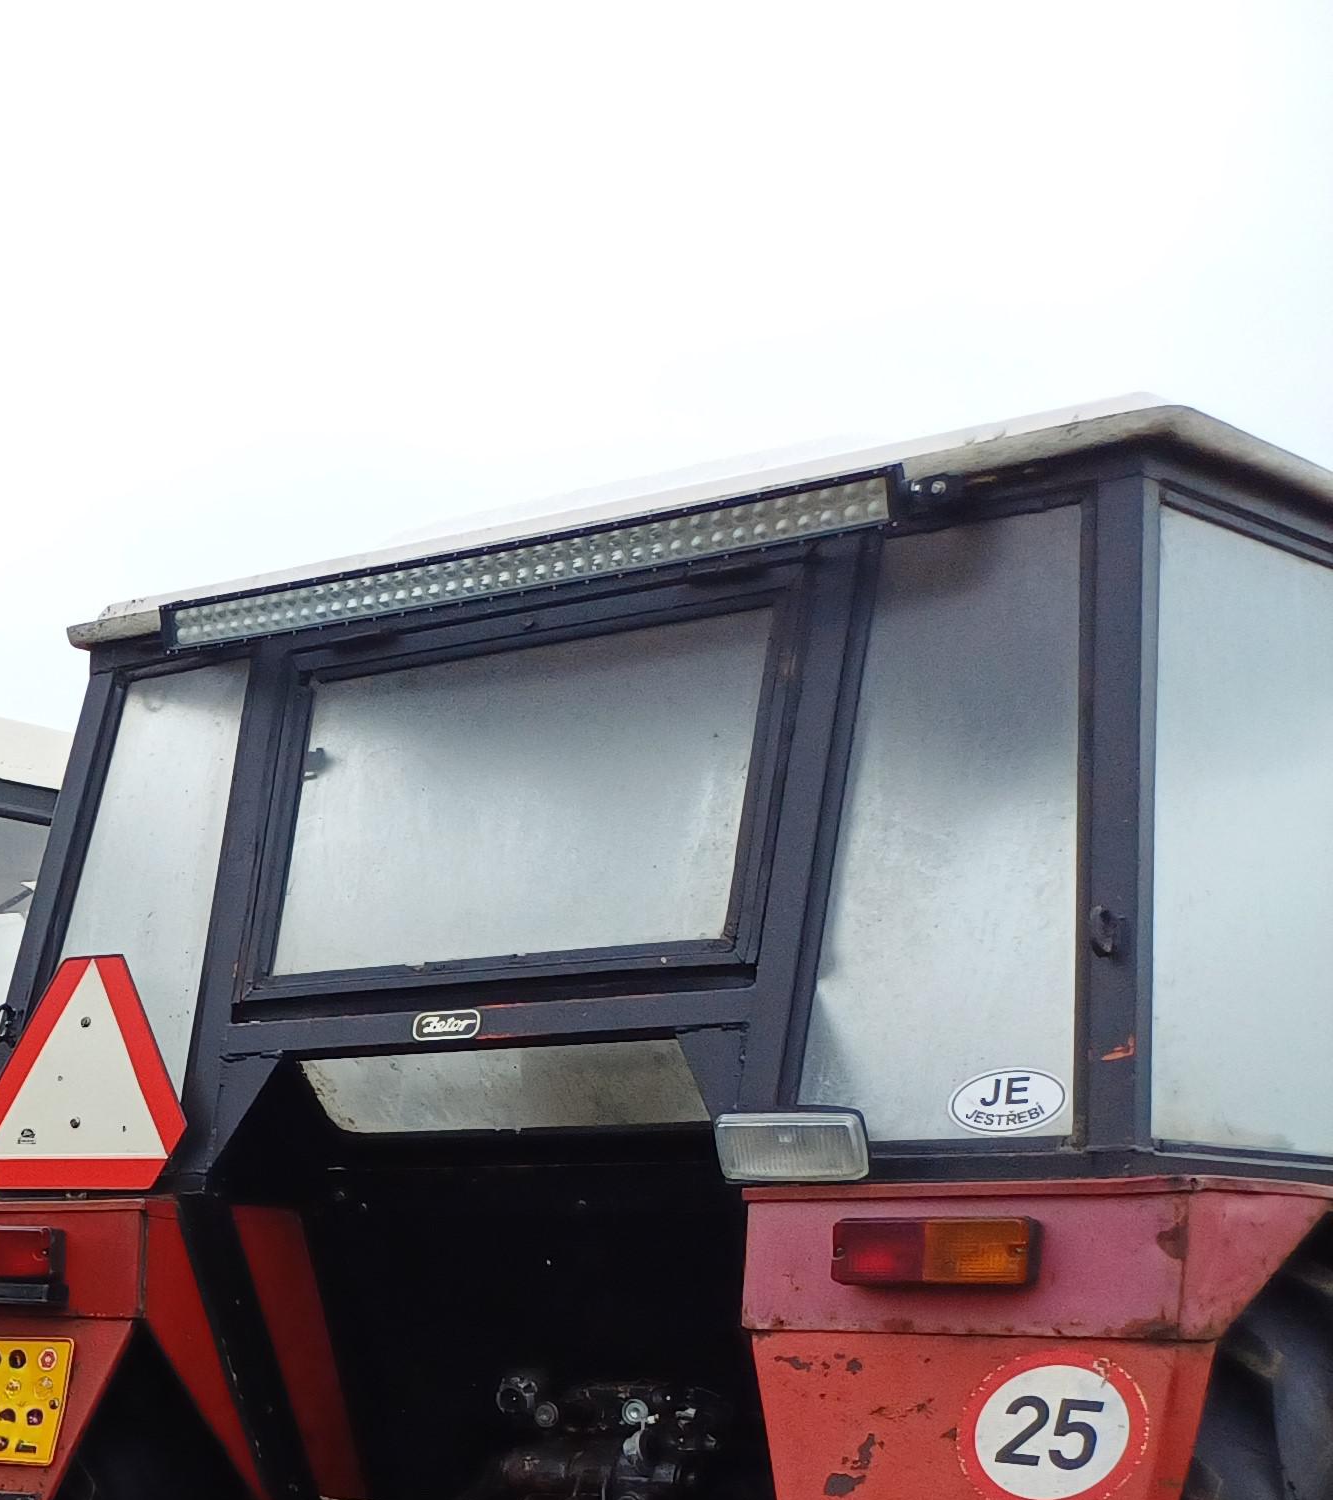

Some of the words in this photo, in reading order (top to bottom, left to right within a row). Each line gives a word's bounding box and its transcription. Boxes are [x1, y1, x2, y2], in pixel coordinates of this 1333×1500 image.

[979, 1076, 1031, 1107] JE
[965, 1101, 1045, 1126] JESTŘEBÍ
[994, 1395, 1105, 1471] 25
